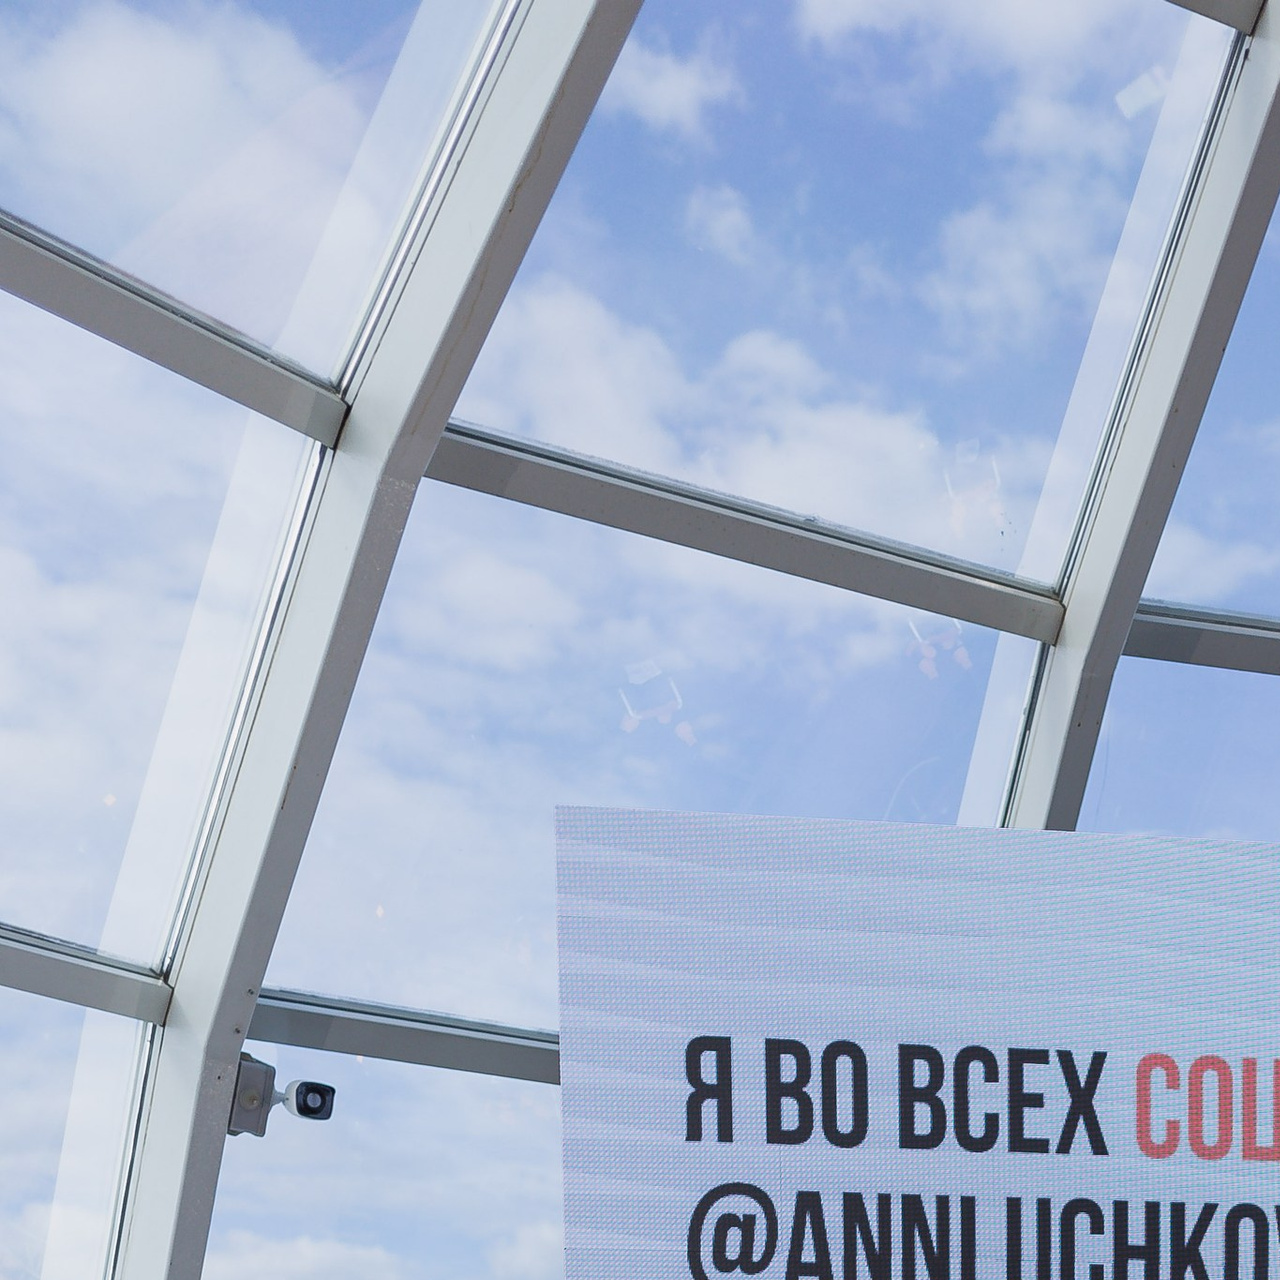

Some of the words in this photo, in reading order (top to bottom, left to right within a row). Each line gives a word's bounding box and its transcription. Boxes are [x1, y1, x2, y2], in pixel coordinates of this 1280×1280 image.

[685, 1035, 733, 1144] Я
[765, 1038, 869, 1150] ВО
[899, 1044, 1109, 1157] ВСЕХ
